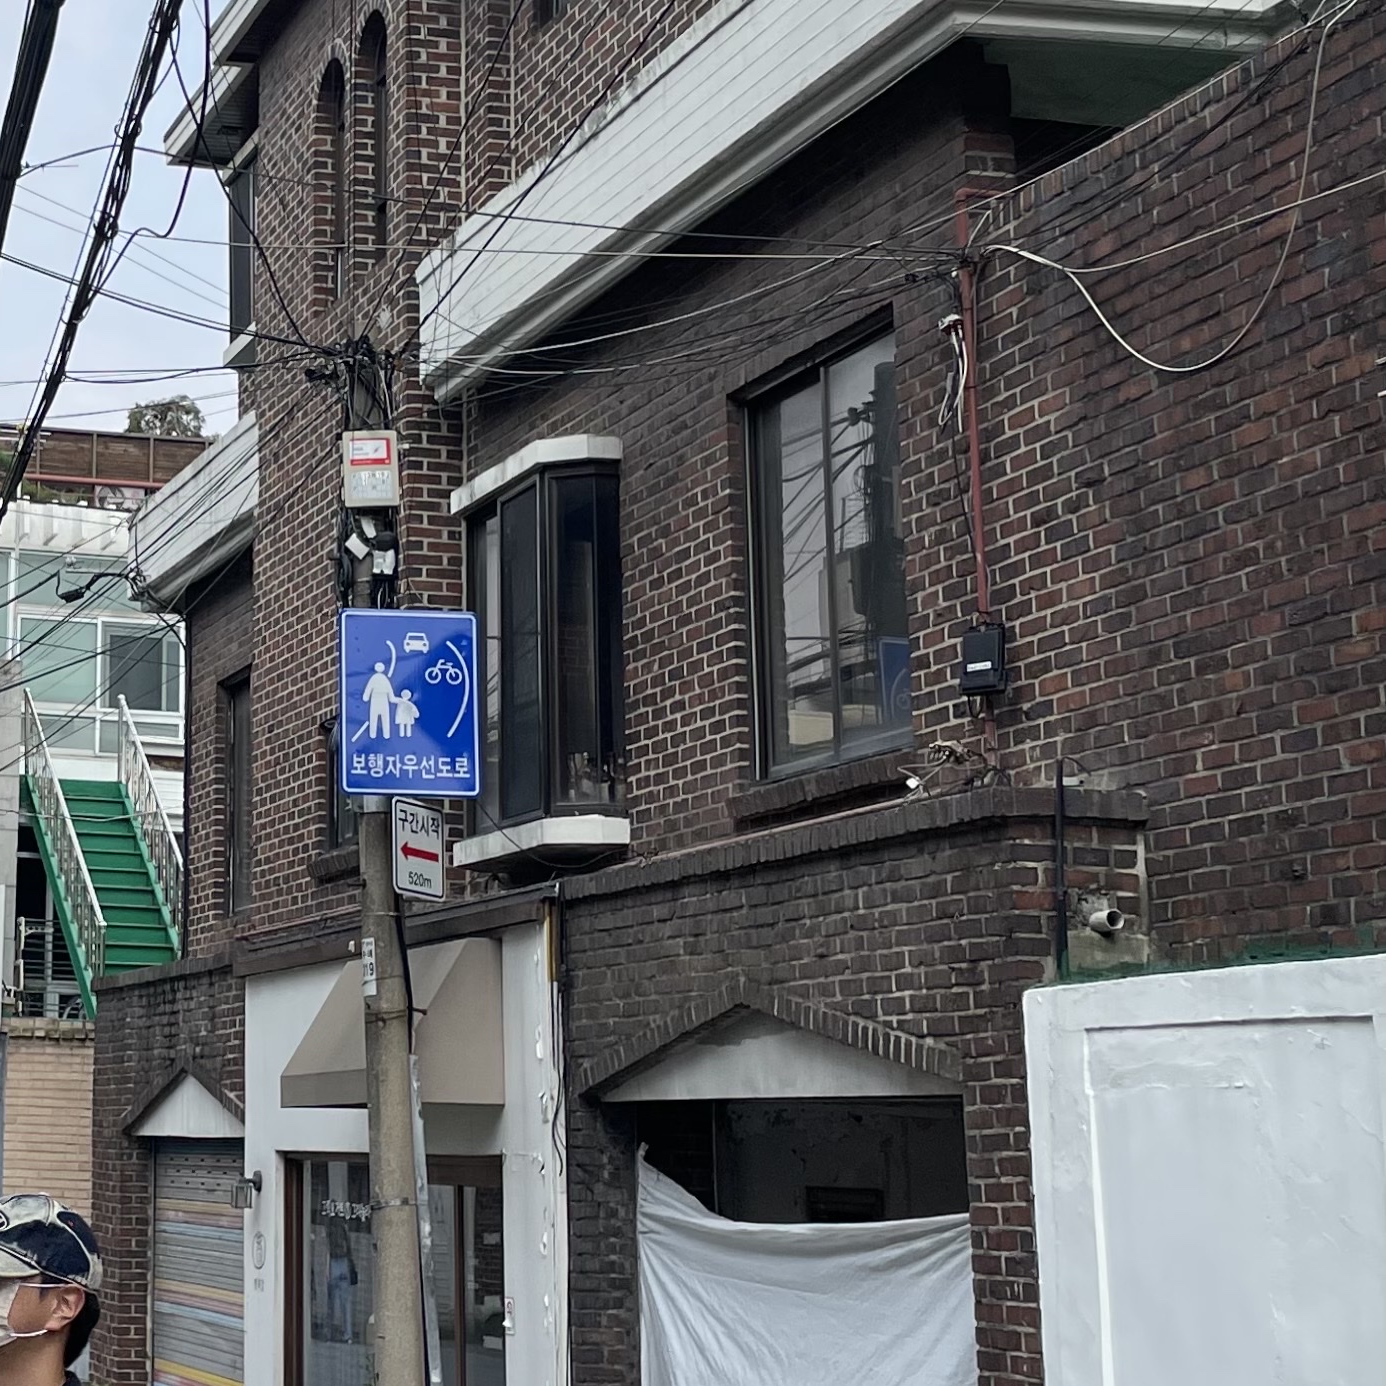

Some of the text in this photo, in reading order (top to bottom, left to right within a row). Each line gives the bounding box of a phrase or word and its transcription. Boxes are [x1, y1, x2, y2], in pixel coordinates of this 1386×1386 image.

[350, 753, 471, 779] 보행자우선도로
[398, 808, 440, 841] 구간시작
[408, 870, 432, 889] 520m
